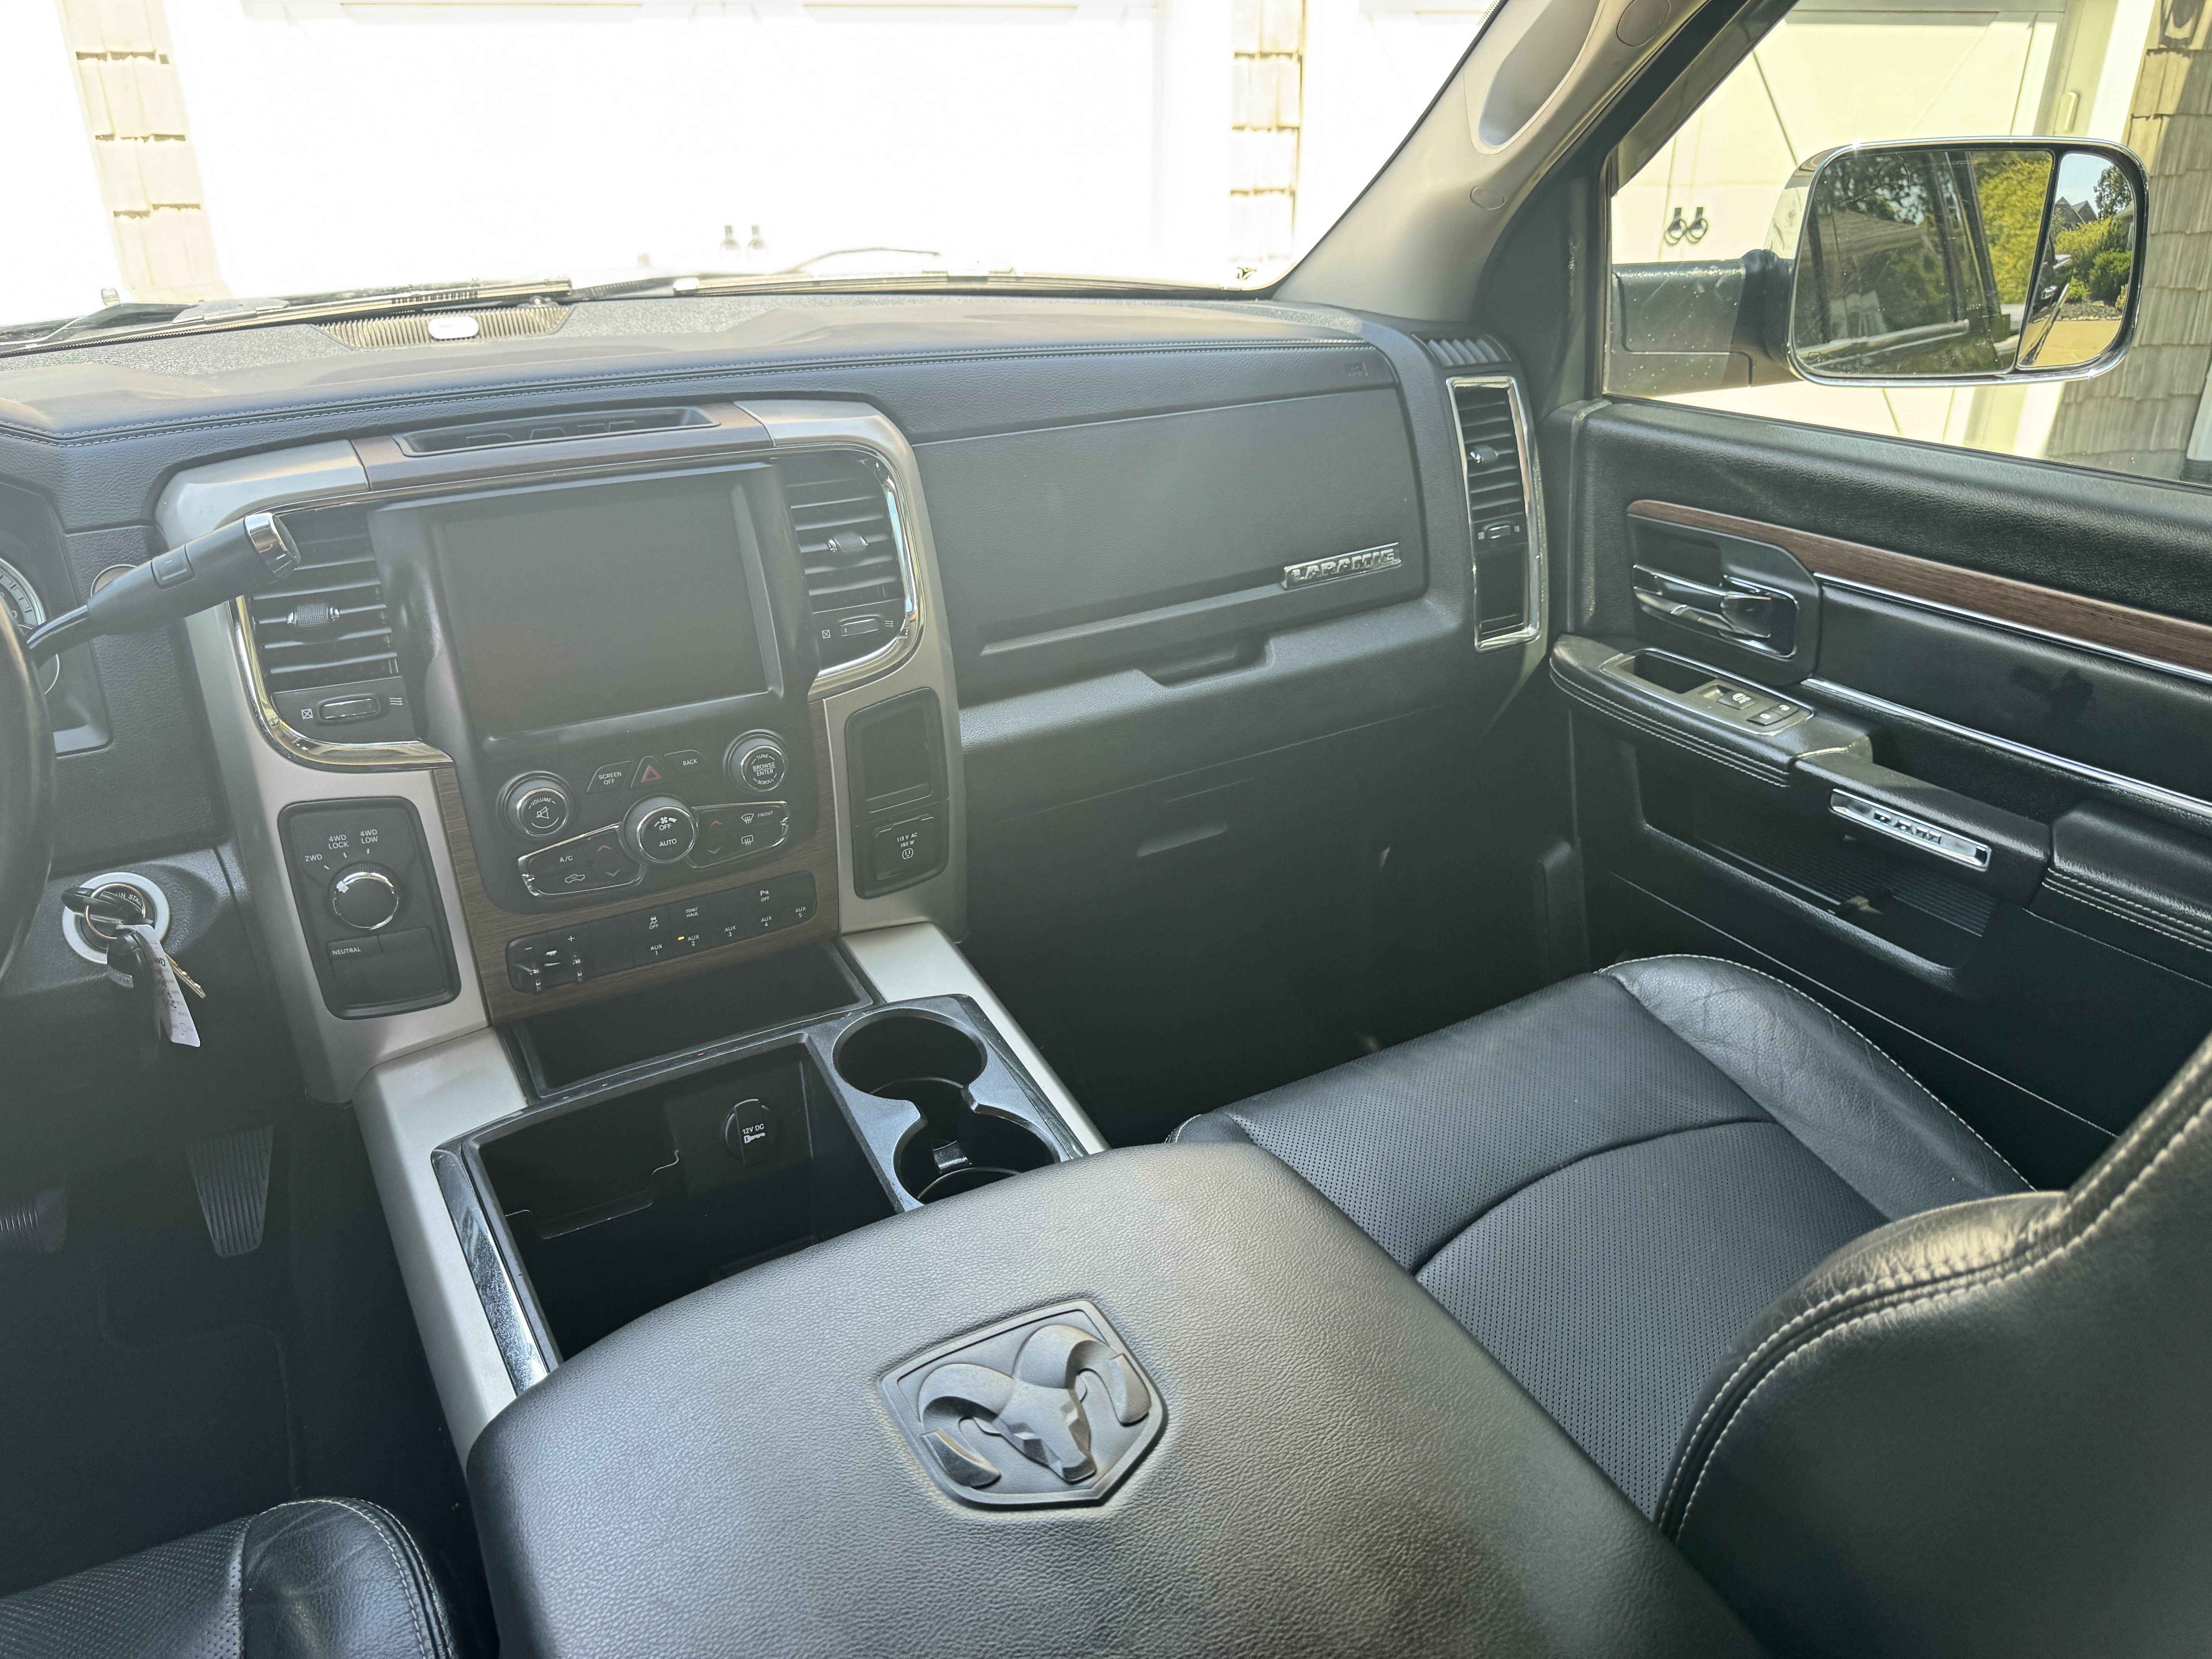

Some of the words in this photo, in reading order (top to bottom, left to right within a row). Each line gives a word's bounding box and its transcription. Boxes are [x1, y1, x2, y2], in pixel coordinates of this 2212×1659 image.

[753, 762, 775, 770] BROWSE
[599, 771, 622, 780] SCREEN
[531, 797, 551, 805] VOLUME
[329, 841, 349, 849] LOCK
[659, 838, 677, 847] AUTO
[742, 1126, 754, 1135] 12V
